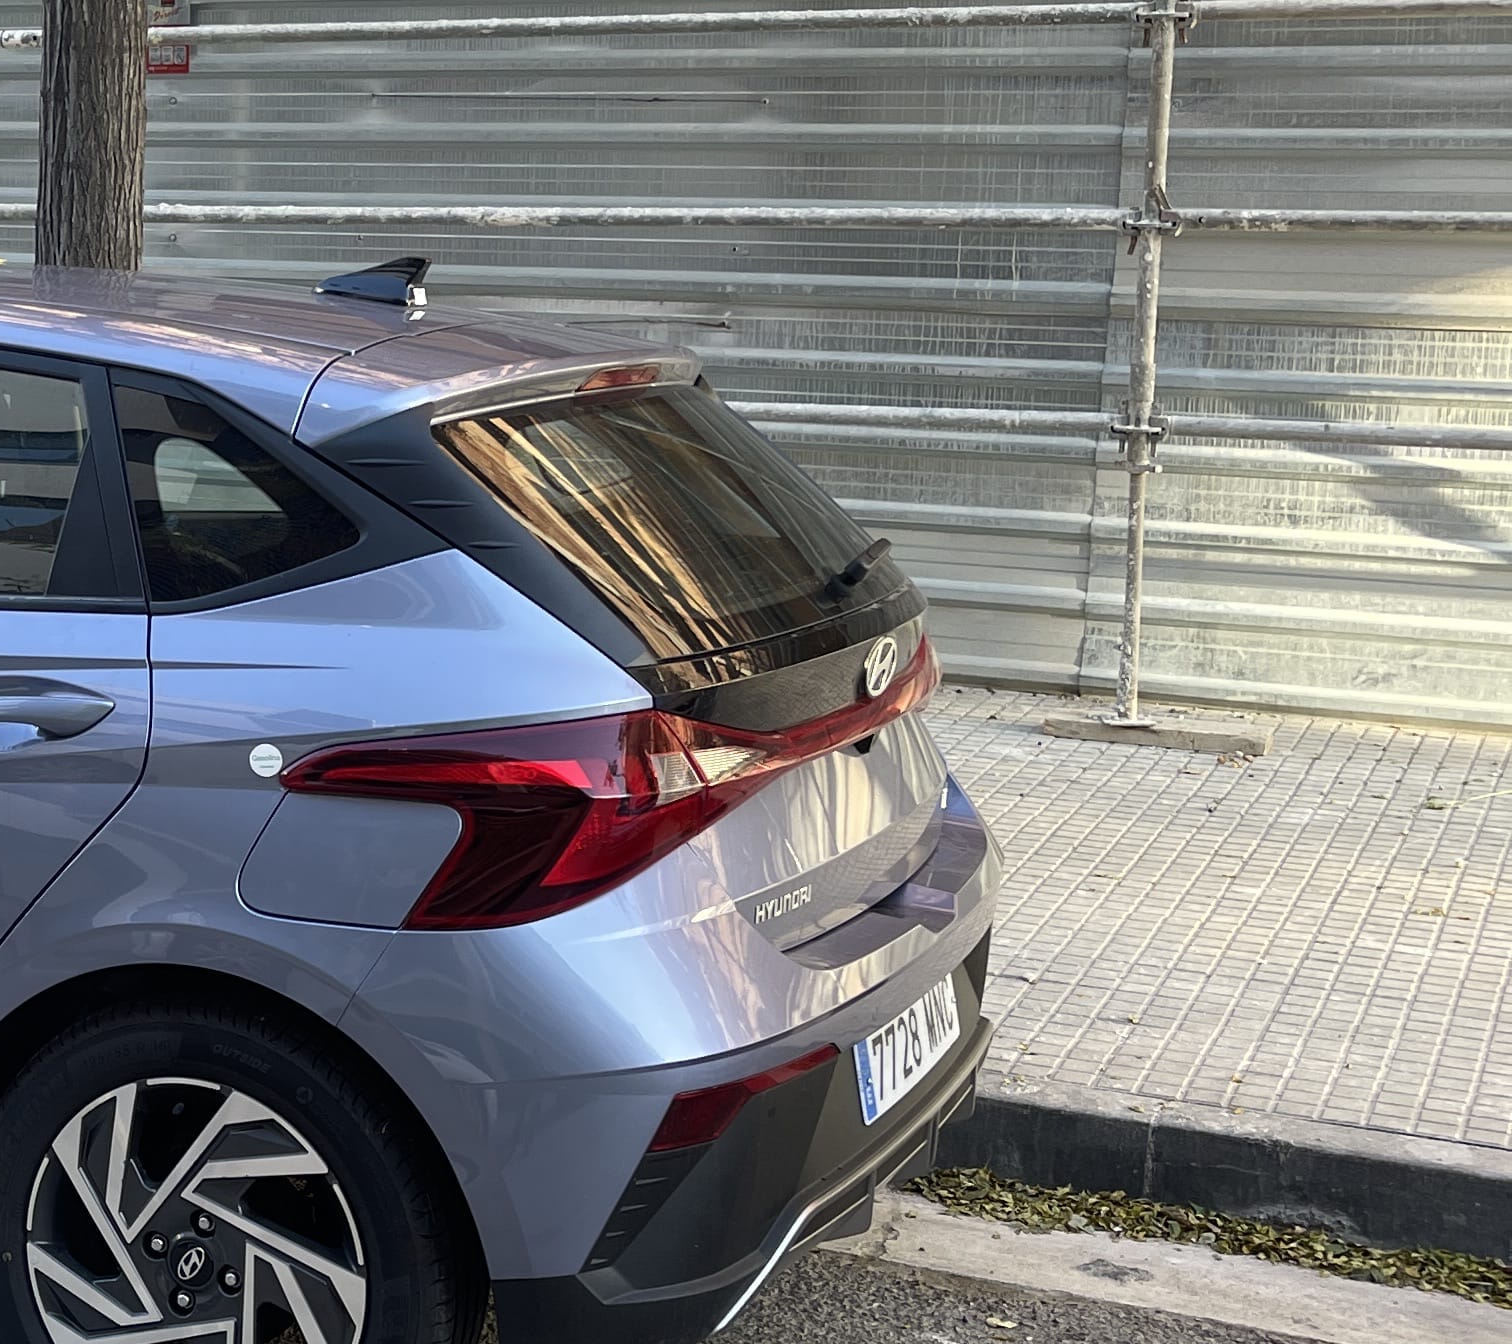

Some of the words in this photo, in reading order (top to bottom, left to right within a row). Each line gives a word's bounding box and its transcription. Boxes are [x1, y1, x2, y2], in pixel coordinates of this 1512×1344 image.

[754, 883, 812, 925] HYUNDAI
[212, 1043, 272, 1074] OUTSIDE
[871, 1007, 922, 1101] 7728
[922, 980, 954, 1053] MNC
